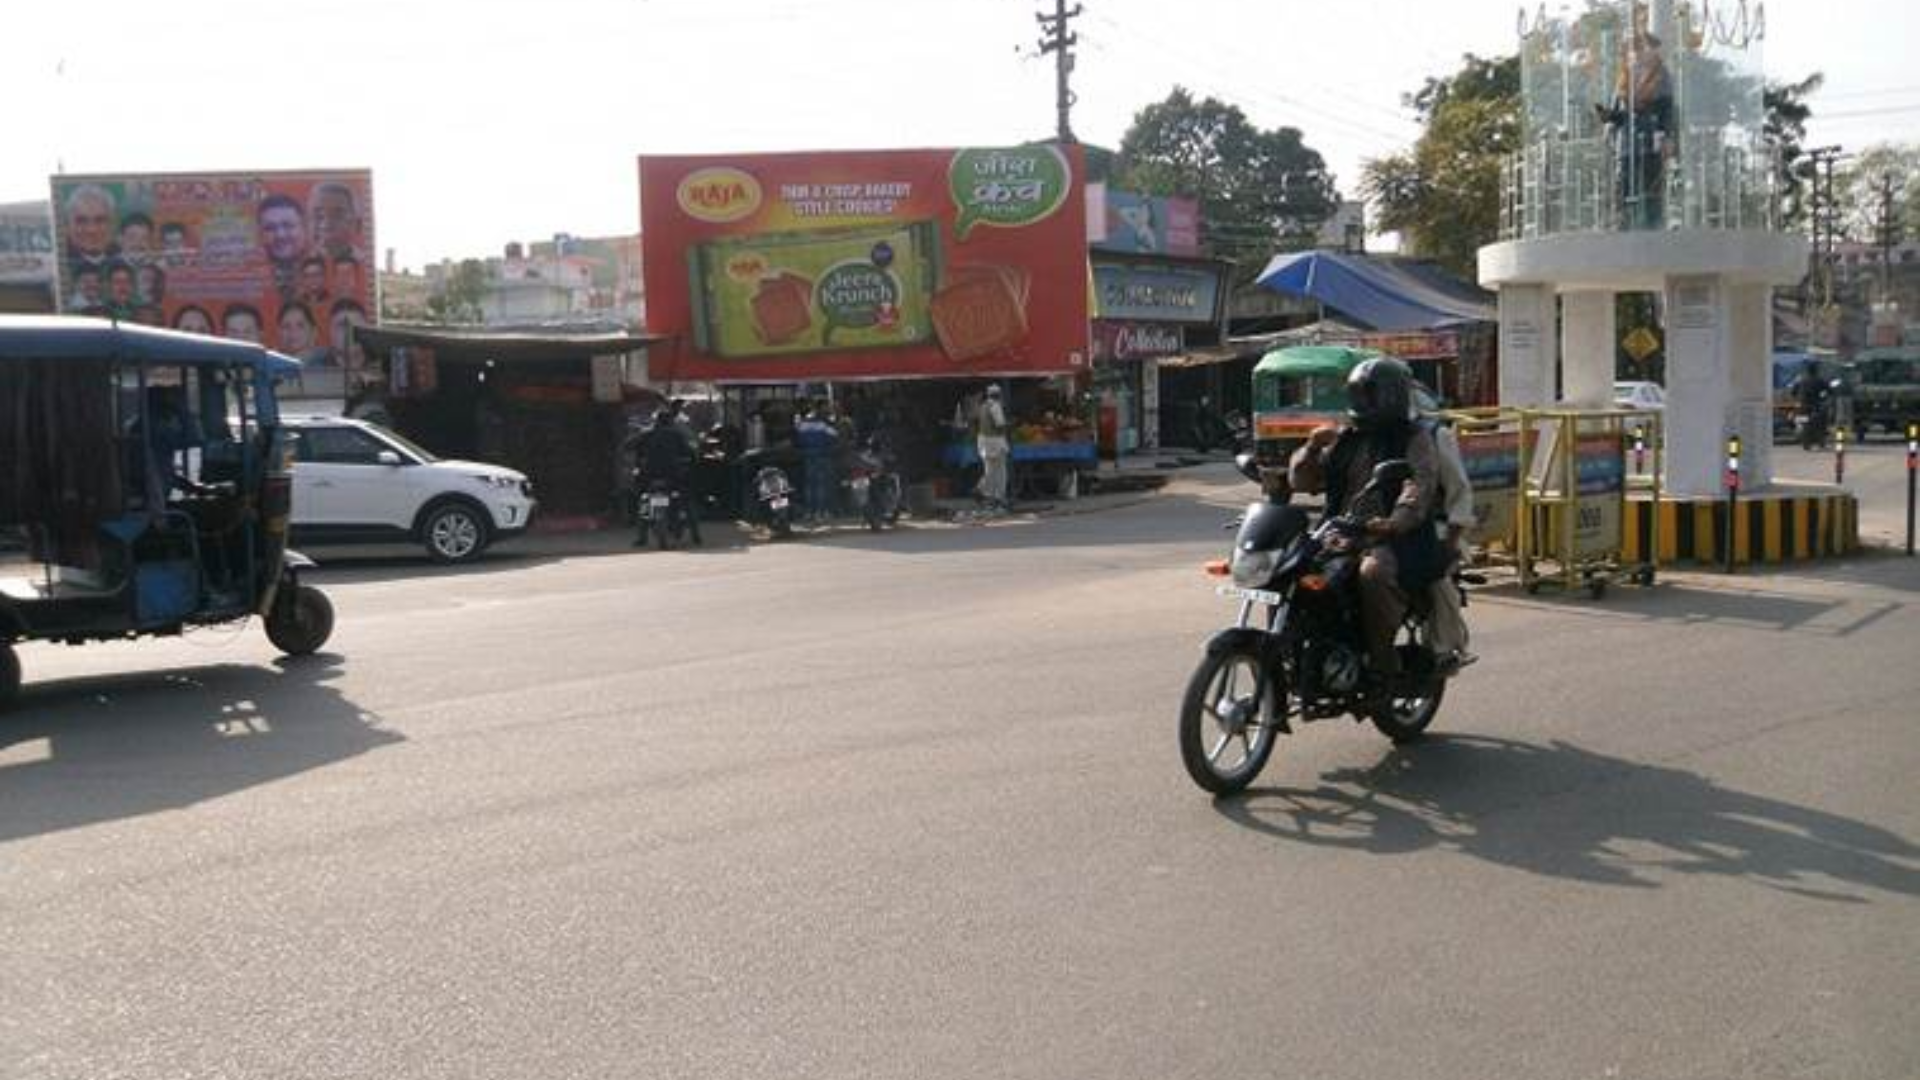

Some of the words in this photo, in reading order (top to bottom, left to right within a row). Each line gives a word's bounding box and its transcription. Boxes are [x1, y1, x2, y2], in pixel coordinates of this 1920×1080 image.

[690, 183, 746, 209] RAJA
[795, 200, 830, 215] STYLE
[829, 271, 883, 289] Jeera
[821, 283, 893, 307] Krunch
